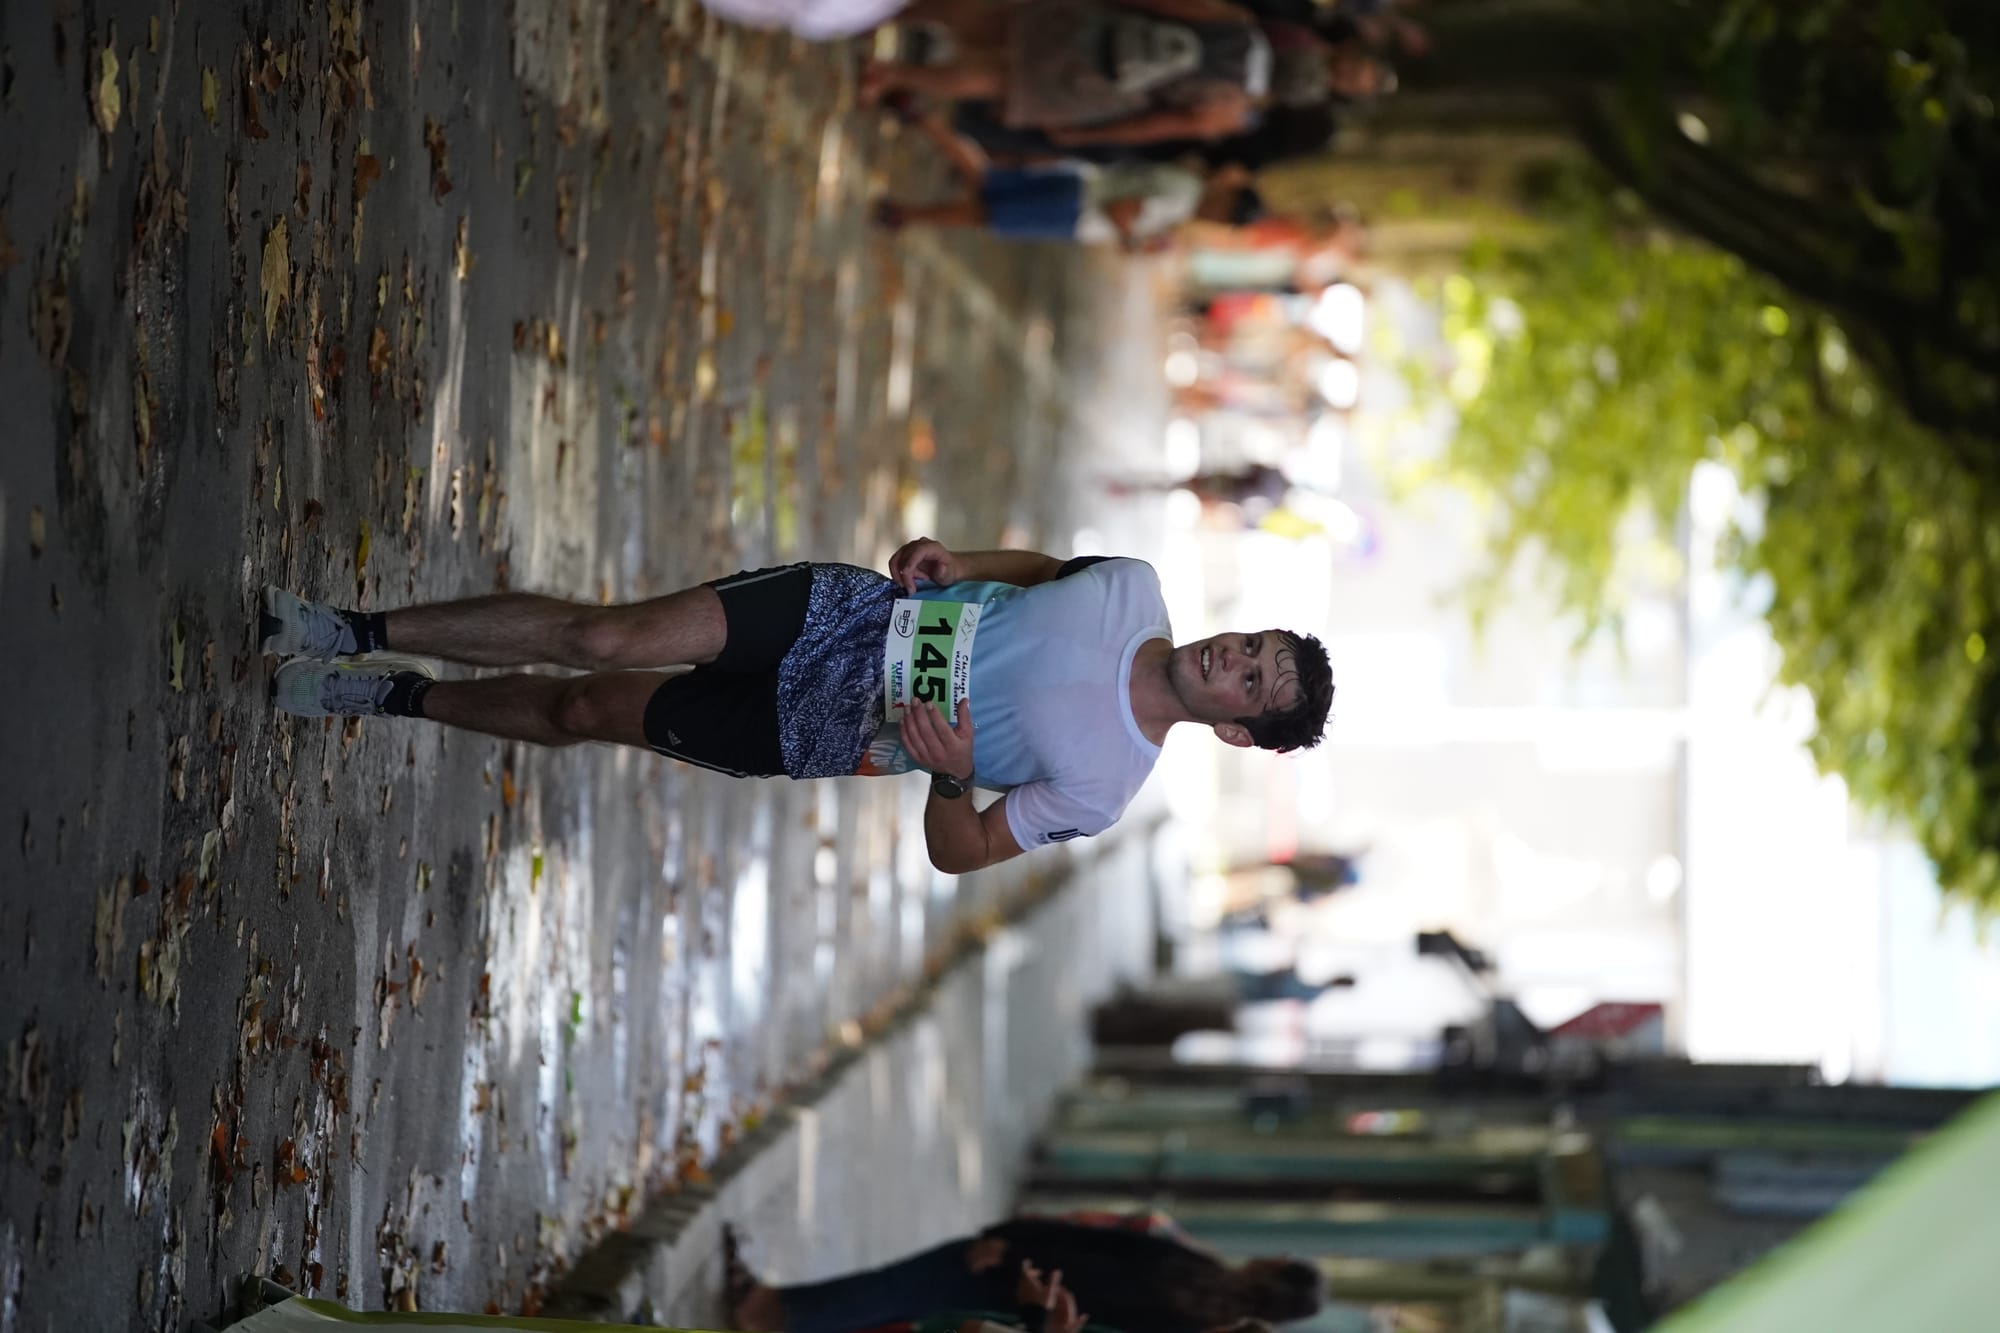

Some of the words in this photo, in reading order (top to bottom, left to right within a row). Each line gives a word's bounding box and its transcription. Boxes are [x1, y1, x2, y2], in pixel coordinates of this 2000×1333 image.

[901, 610, 911, 634] BFP
[913, 618, 953, 702] 145
[959, 655, 968, 694] Challenge
